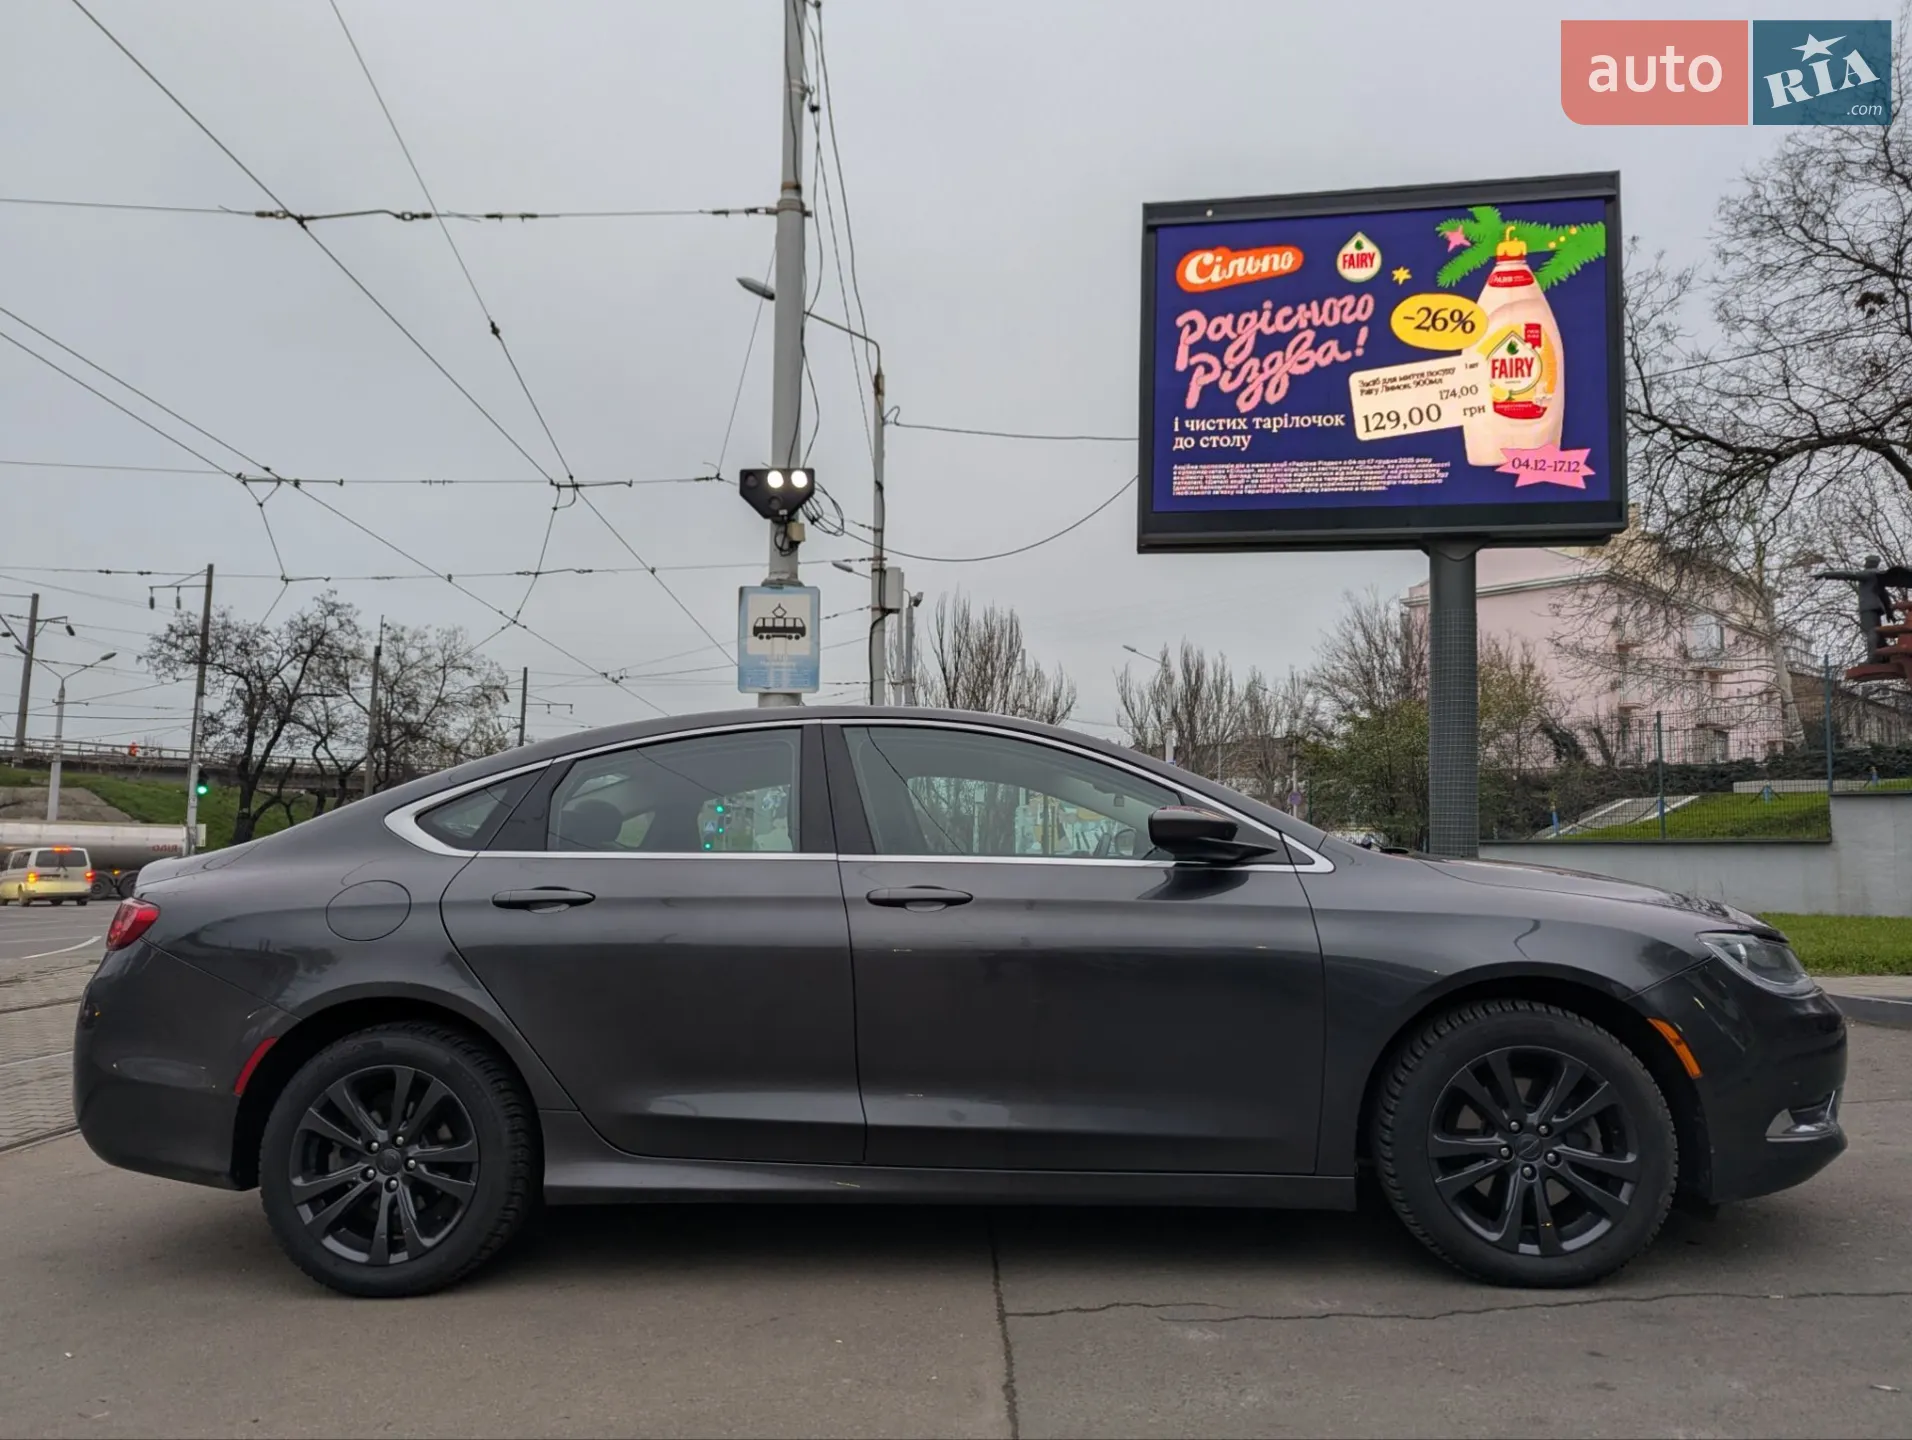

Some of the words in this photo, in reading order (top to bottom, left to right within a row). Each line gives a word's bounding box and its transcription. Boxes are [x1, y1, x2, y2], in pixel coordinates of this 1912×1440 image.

[1184, 251, 1295, 285] Сільпо
[1341, 252, 1375, 270] FAIRY
[1403, 306, 1476, 335] -26%
[1175, 293, 1375, 372] Радісного
[1491, 357, 1534, 379] FAIRY
[1439, 384, 1479, 400] 174,00
[1185, 417, 1248, 431] чистих
[1252, 413, 1345, 433] тарілочок
[1362, 403, 1442, 433] 129,00
[1463, 405, 1486, 417] грн
[1173, 437, 1195, 451] до
[1200, 434, 1252, 452] столу
